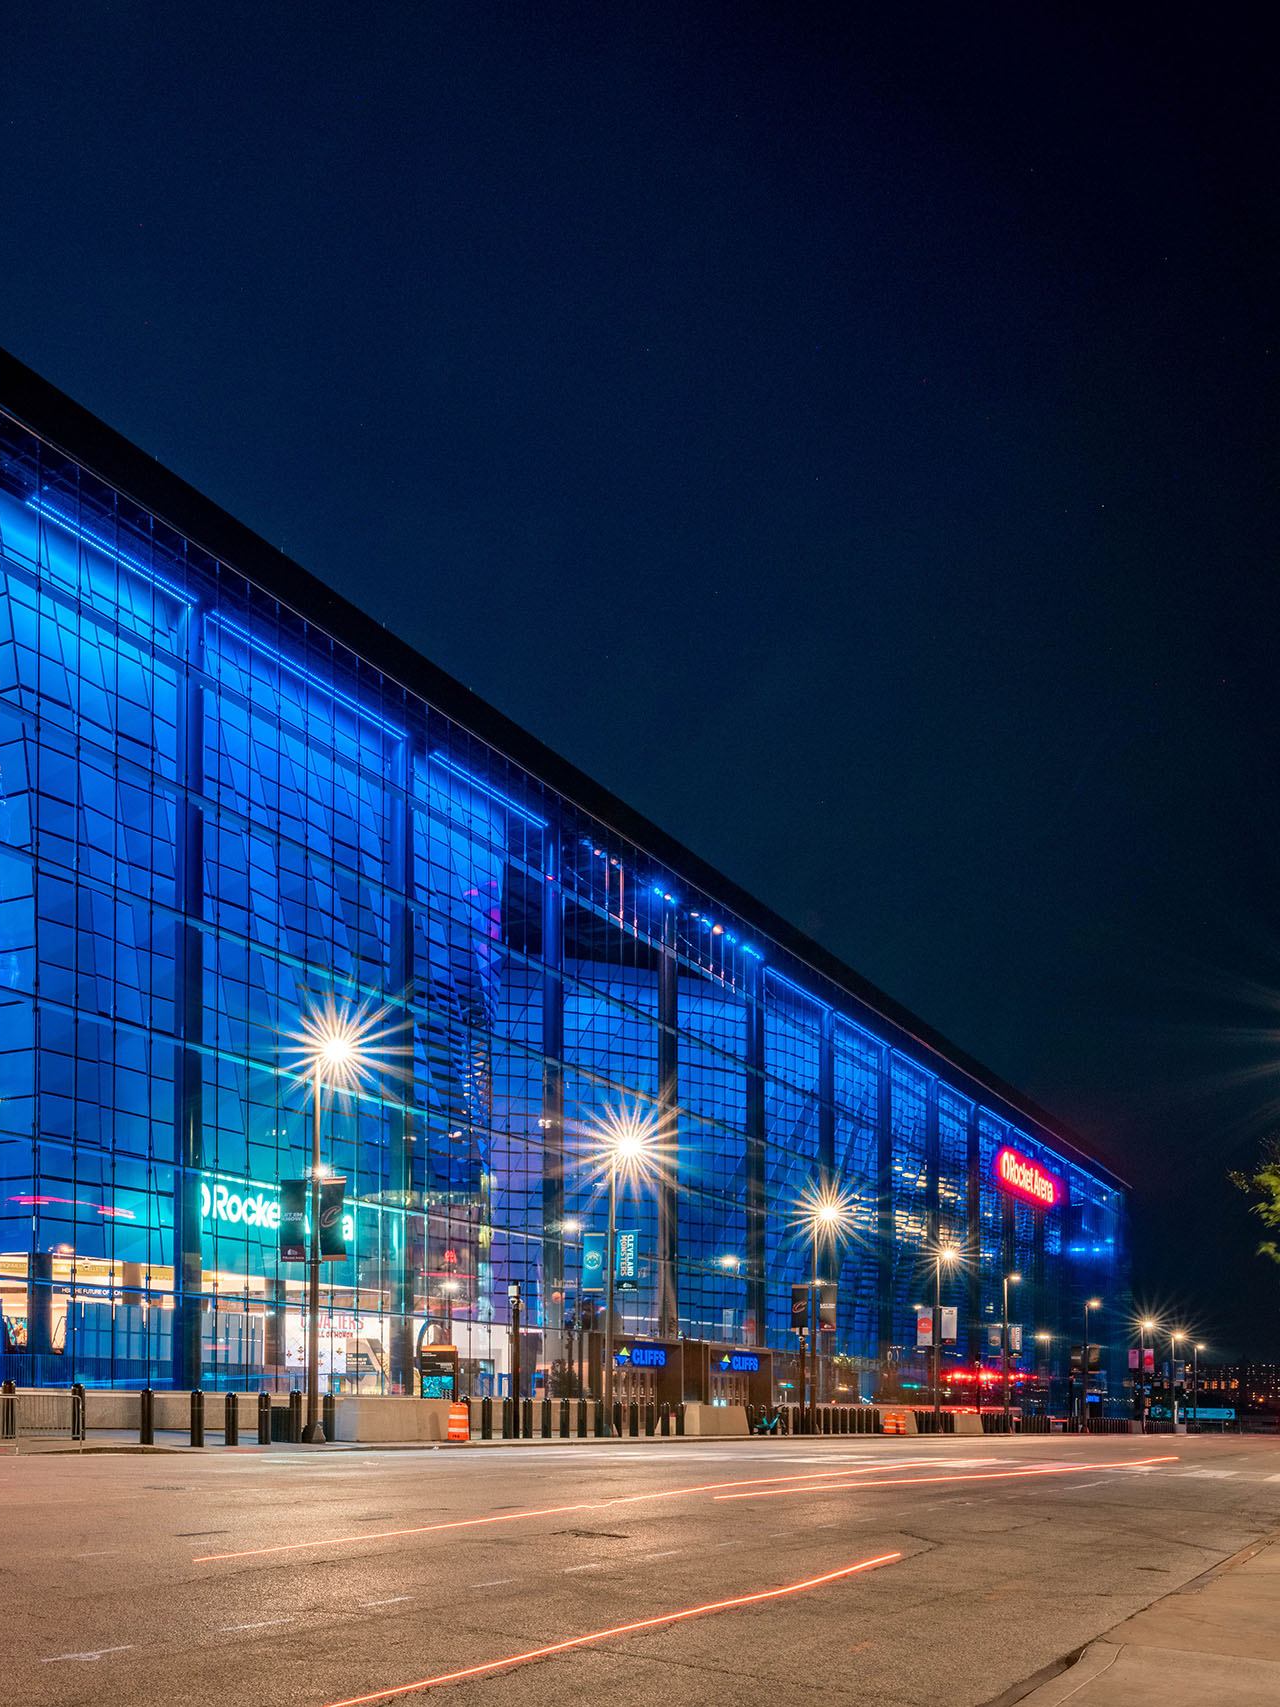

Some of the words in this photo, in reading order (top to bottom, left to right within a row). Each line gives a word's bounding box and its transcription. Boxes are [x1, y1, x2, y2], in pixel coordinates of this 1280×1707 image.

[1009, 1153, 1034, 1194] Rocket
[1034, 1168, 1054, 1203] Arena
[213, 1183, 281, 1229] Rocke
[620, 1234, 628, 1277] MONSTERS
[627, 1234, 635, 1277] CLEVELAND
[632, 1349, 666, 1366] CLIFFS
[732, 1356, 759, 1371] CLIFFS
